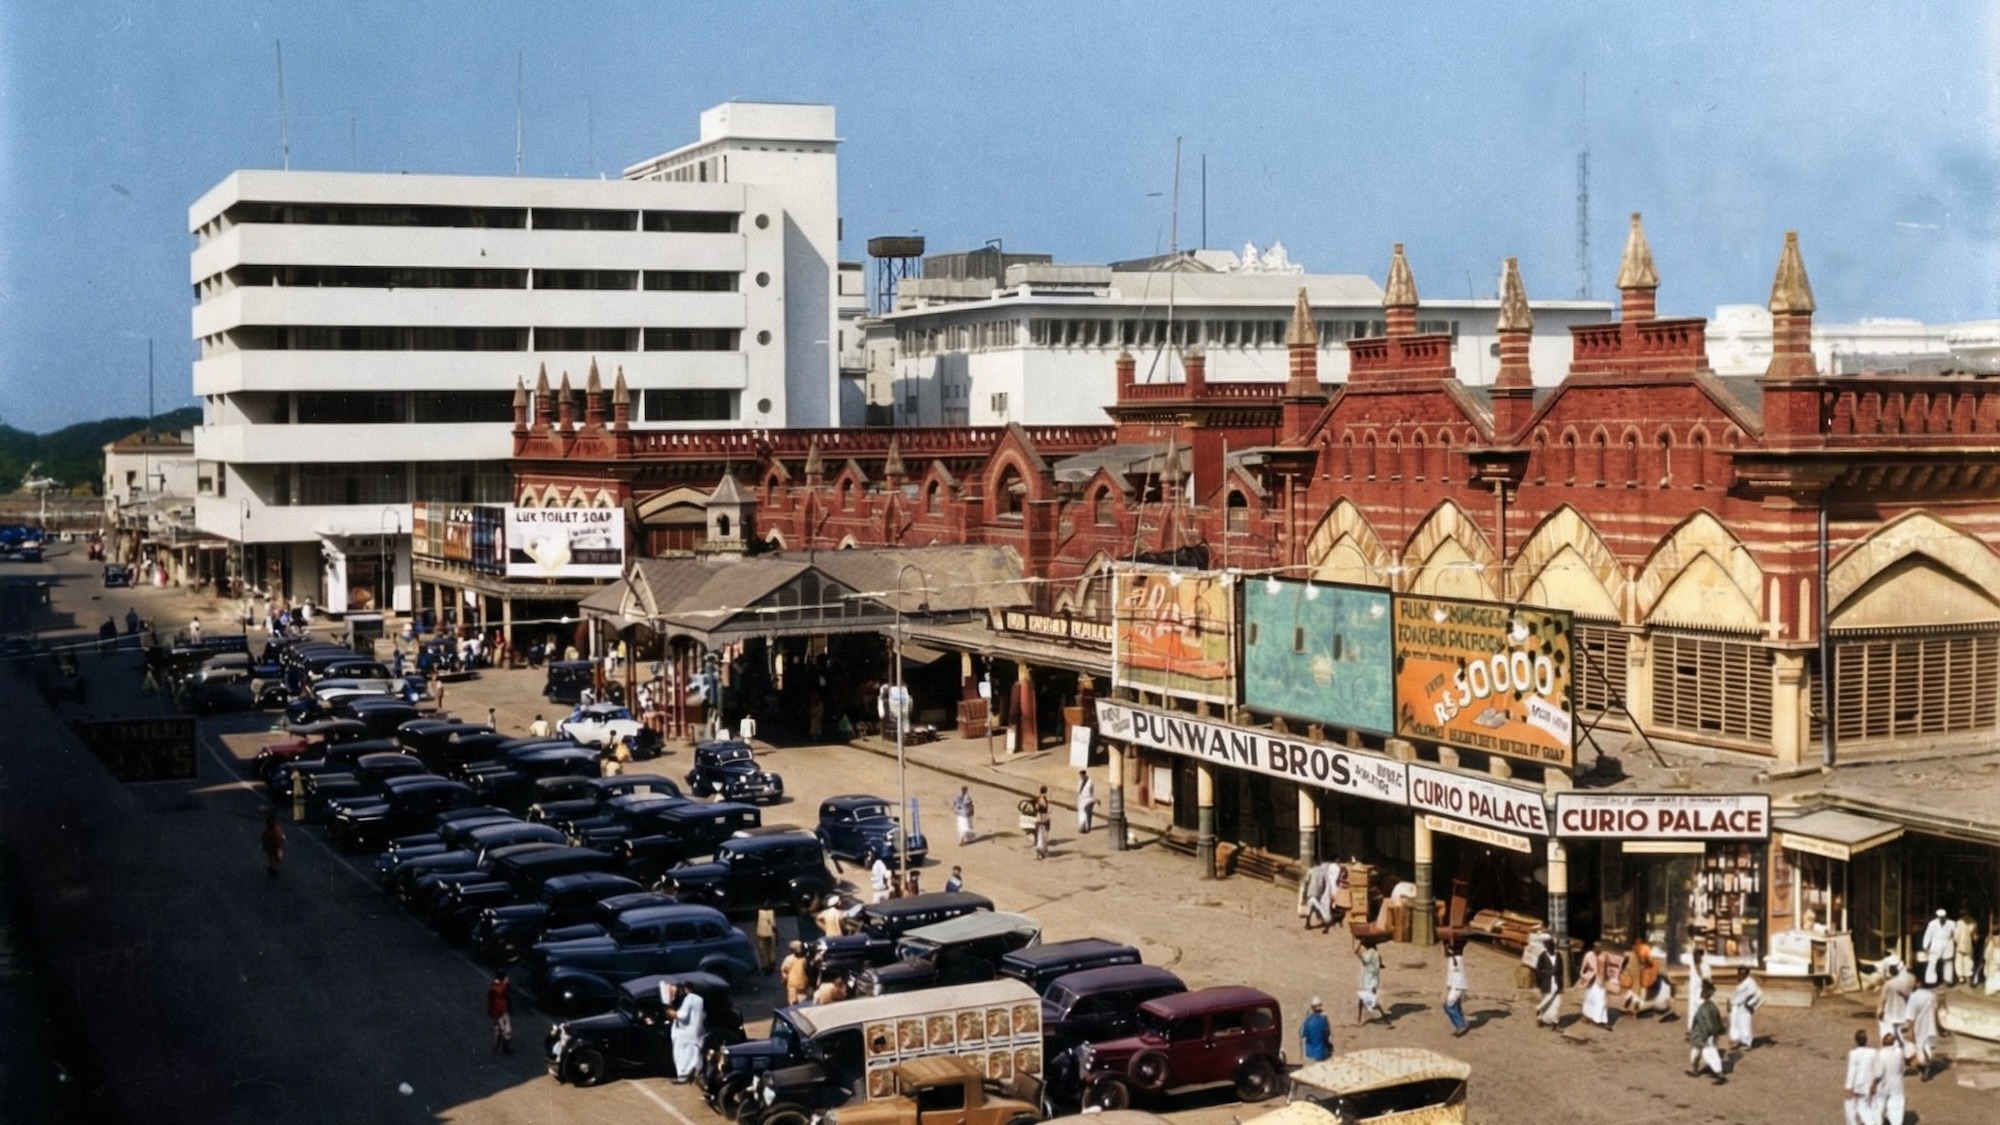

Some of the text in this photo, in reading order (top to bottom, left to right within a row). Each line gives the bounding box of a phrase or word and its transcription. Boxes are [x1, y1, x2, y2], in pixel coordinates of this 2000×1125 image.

[542, 511, 578, 523] TOILET
[583, 511, 612, 523] SOAP
[1132, 711, 1258, 767] PUNWANI
[1268, 740, 1358, 788] BROS.
[1413, 778, 1462, 812] CURIO
[1469, 791, 1544, 830] PALACE
[1562, 809, 1762, 832] CURIO PALACE
